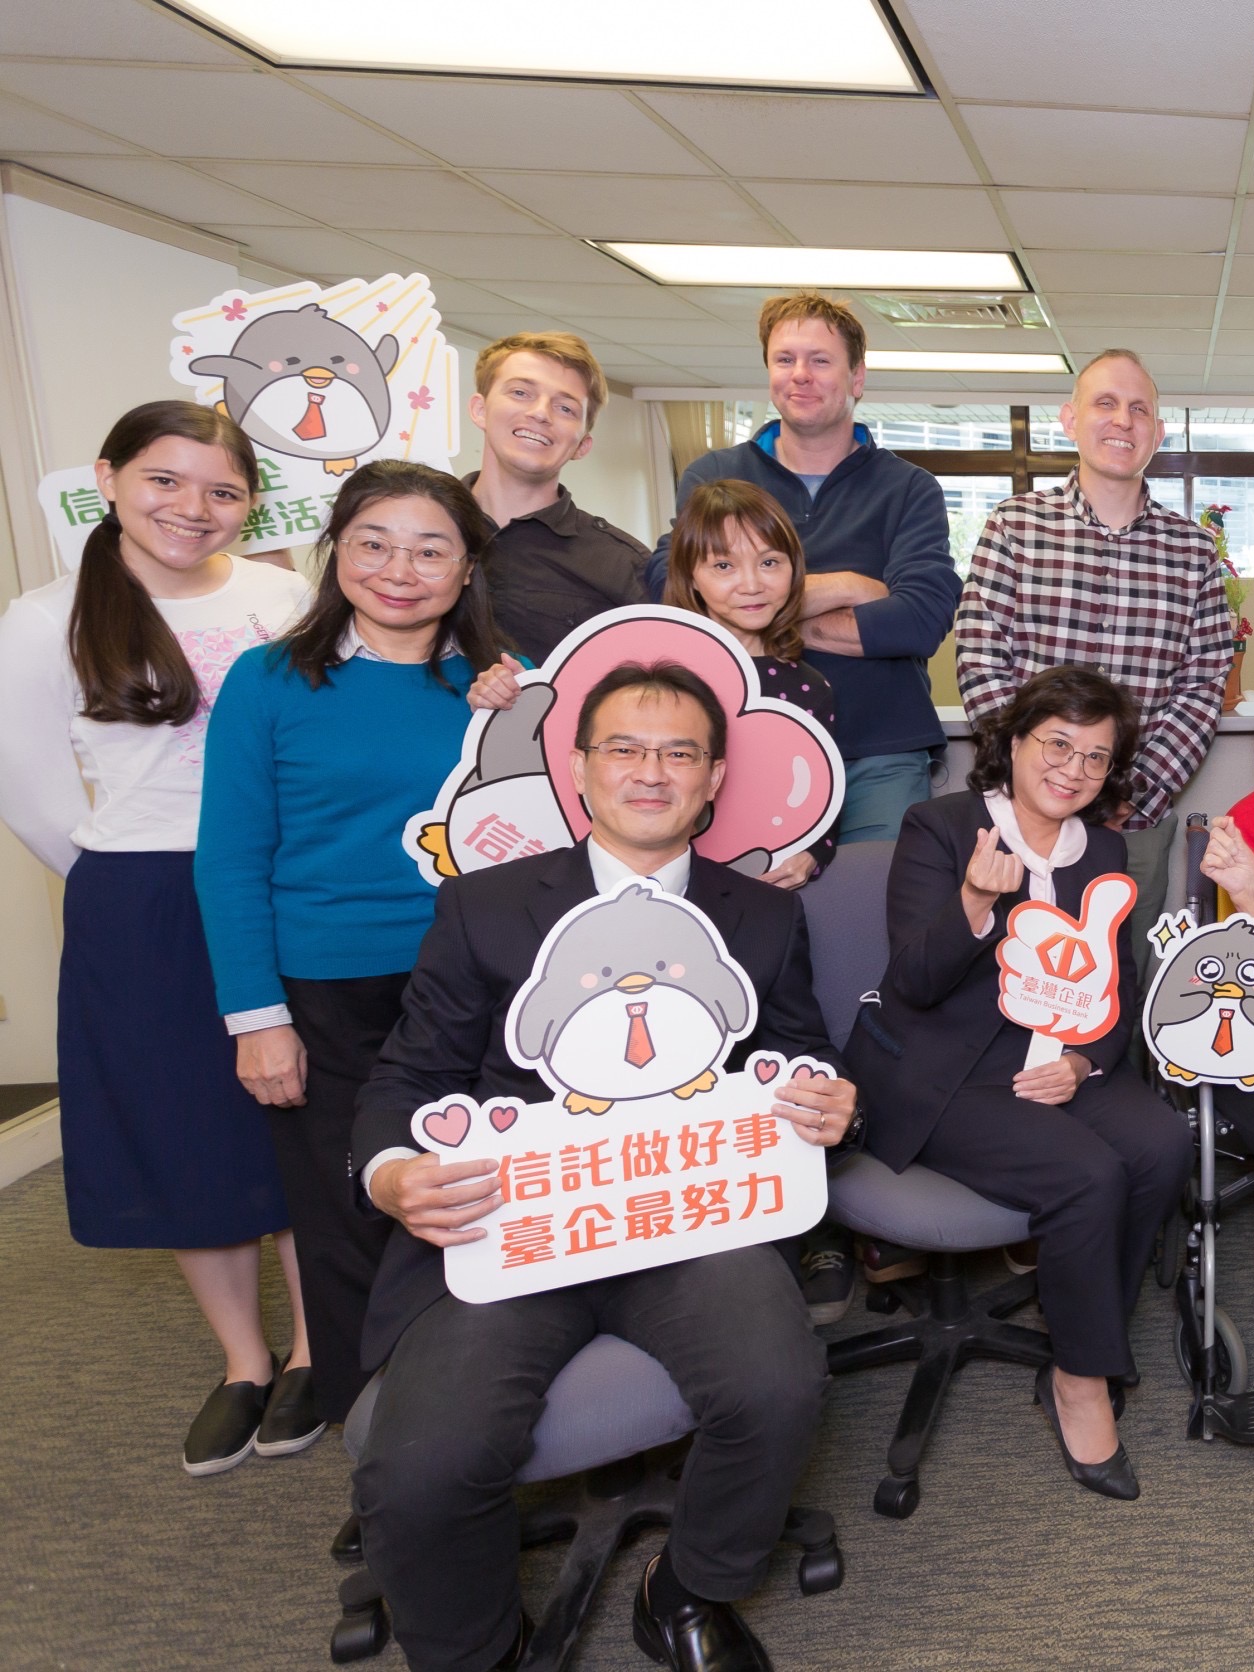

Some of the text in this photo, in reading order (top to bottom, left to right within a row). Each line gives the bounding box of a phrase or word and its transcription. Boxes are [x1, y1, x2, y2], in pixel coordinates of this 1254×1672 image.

[1019, 993, 1089, 1019] Taiwan Business Bank
[1021, 975, 1093, 1010] 臺灣企銀
[497, 1113, 781, 1203] 信託做好事
[500, 1172, 784, 1270] 臺企最努力
